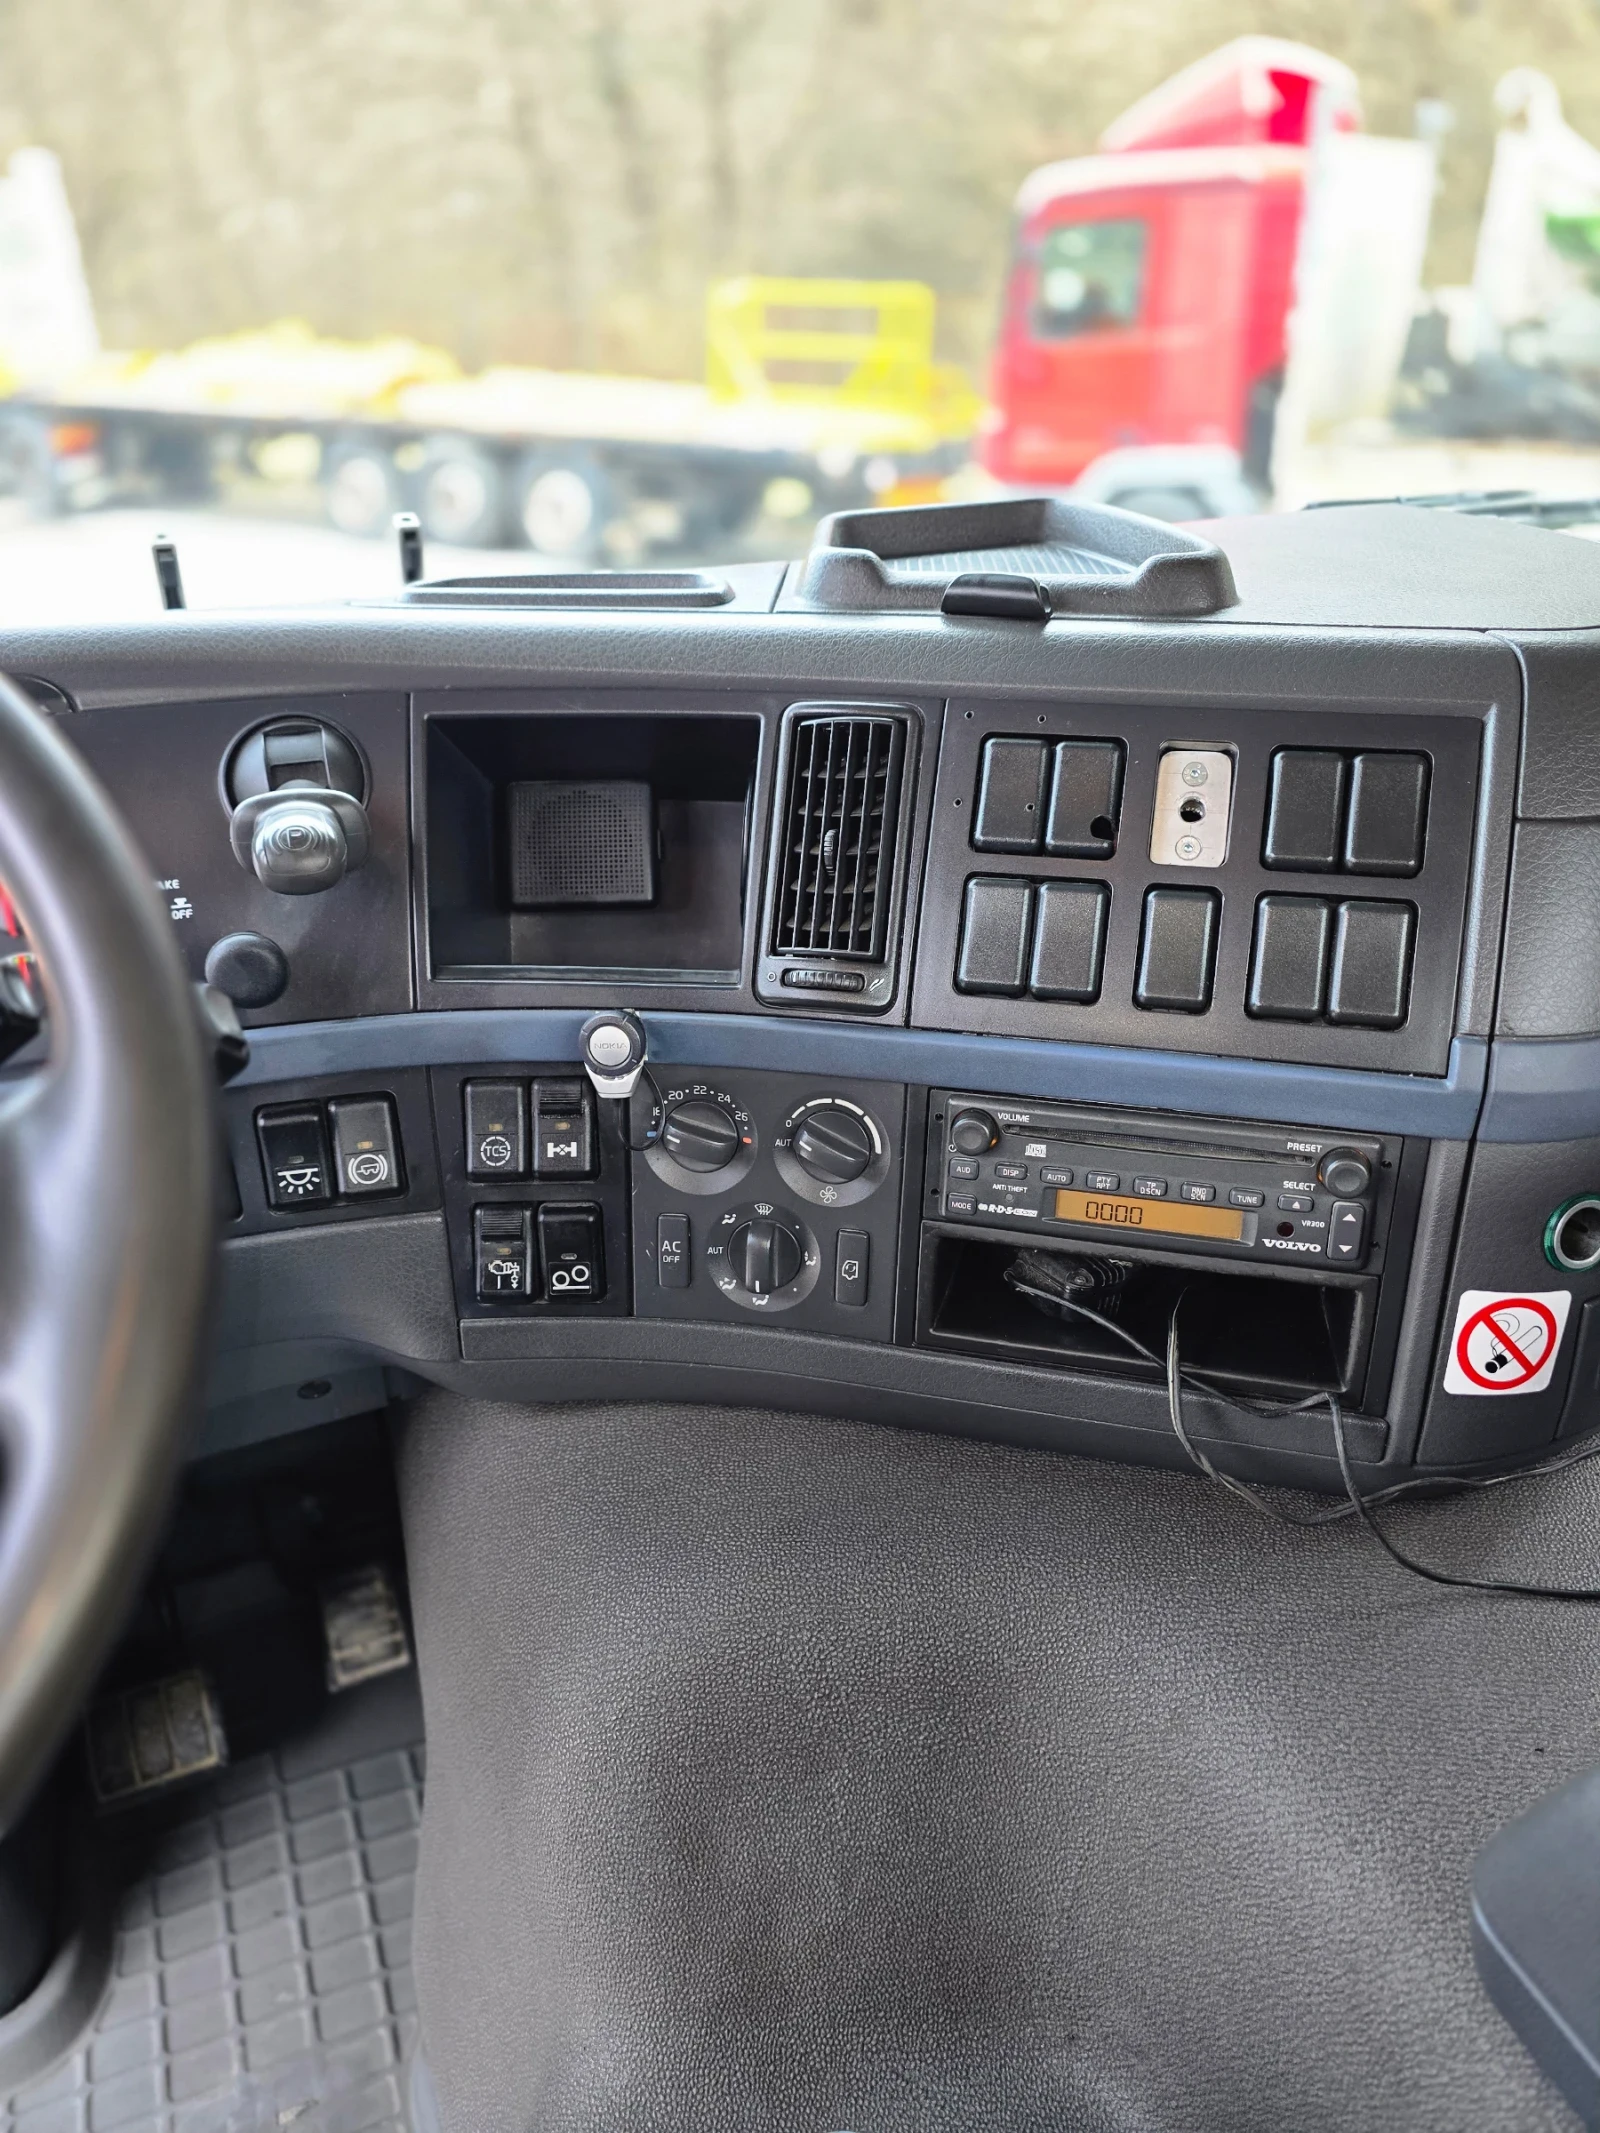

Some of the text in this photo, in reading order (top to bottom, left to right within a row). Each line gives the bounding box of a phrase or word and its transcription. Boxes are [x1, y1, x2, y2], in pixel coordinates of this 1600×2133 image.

[171, 908, 193, 920] OFF
[594, 1042, 627, 1050] NOKIA
[668, 1090, 684, 1100] 20
[693, 1085, 707, 1095] 22
[717, 1092, 731, 1103] 24
[734, 1110, 748, 1122] 26
[997, 1112, 1030, 1123] VOLUME
[774, 1138, 792, 1147] AUT
[1287, 1141, 1323, 1153] PRESET
[484, 1145, 507, 1157] TCS
[956, 1165, 971, 1174] AUD
[1002, 1168, 1019, 1177] DISP
[1046, 1173, 1067, 1183] AUTO
[992, 1183, 1028, 1194] ANTI THEFT
[1146, 1181, 1157, 1189] TP
[1282, 1180, 1317, 1192] SELECT
[1191, 1186, 1207, 1195] RND
[1190, 1193, 1206, 1202] SCN
[1237, 1194, 1258, 1204] TUNE
[951, 1201, 972, 1211] MODE
[1301, 1219, 1326, 1229] VR300
[661, 1240, 682, 1253] AC
[706, 1246, 724, 1255] AUT
[1262, 1239, 1322, 1253] VOLVO
[662, 1254, 681, 1264] OFF
